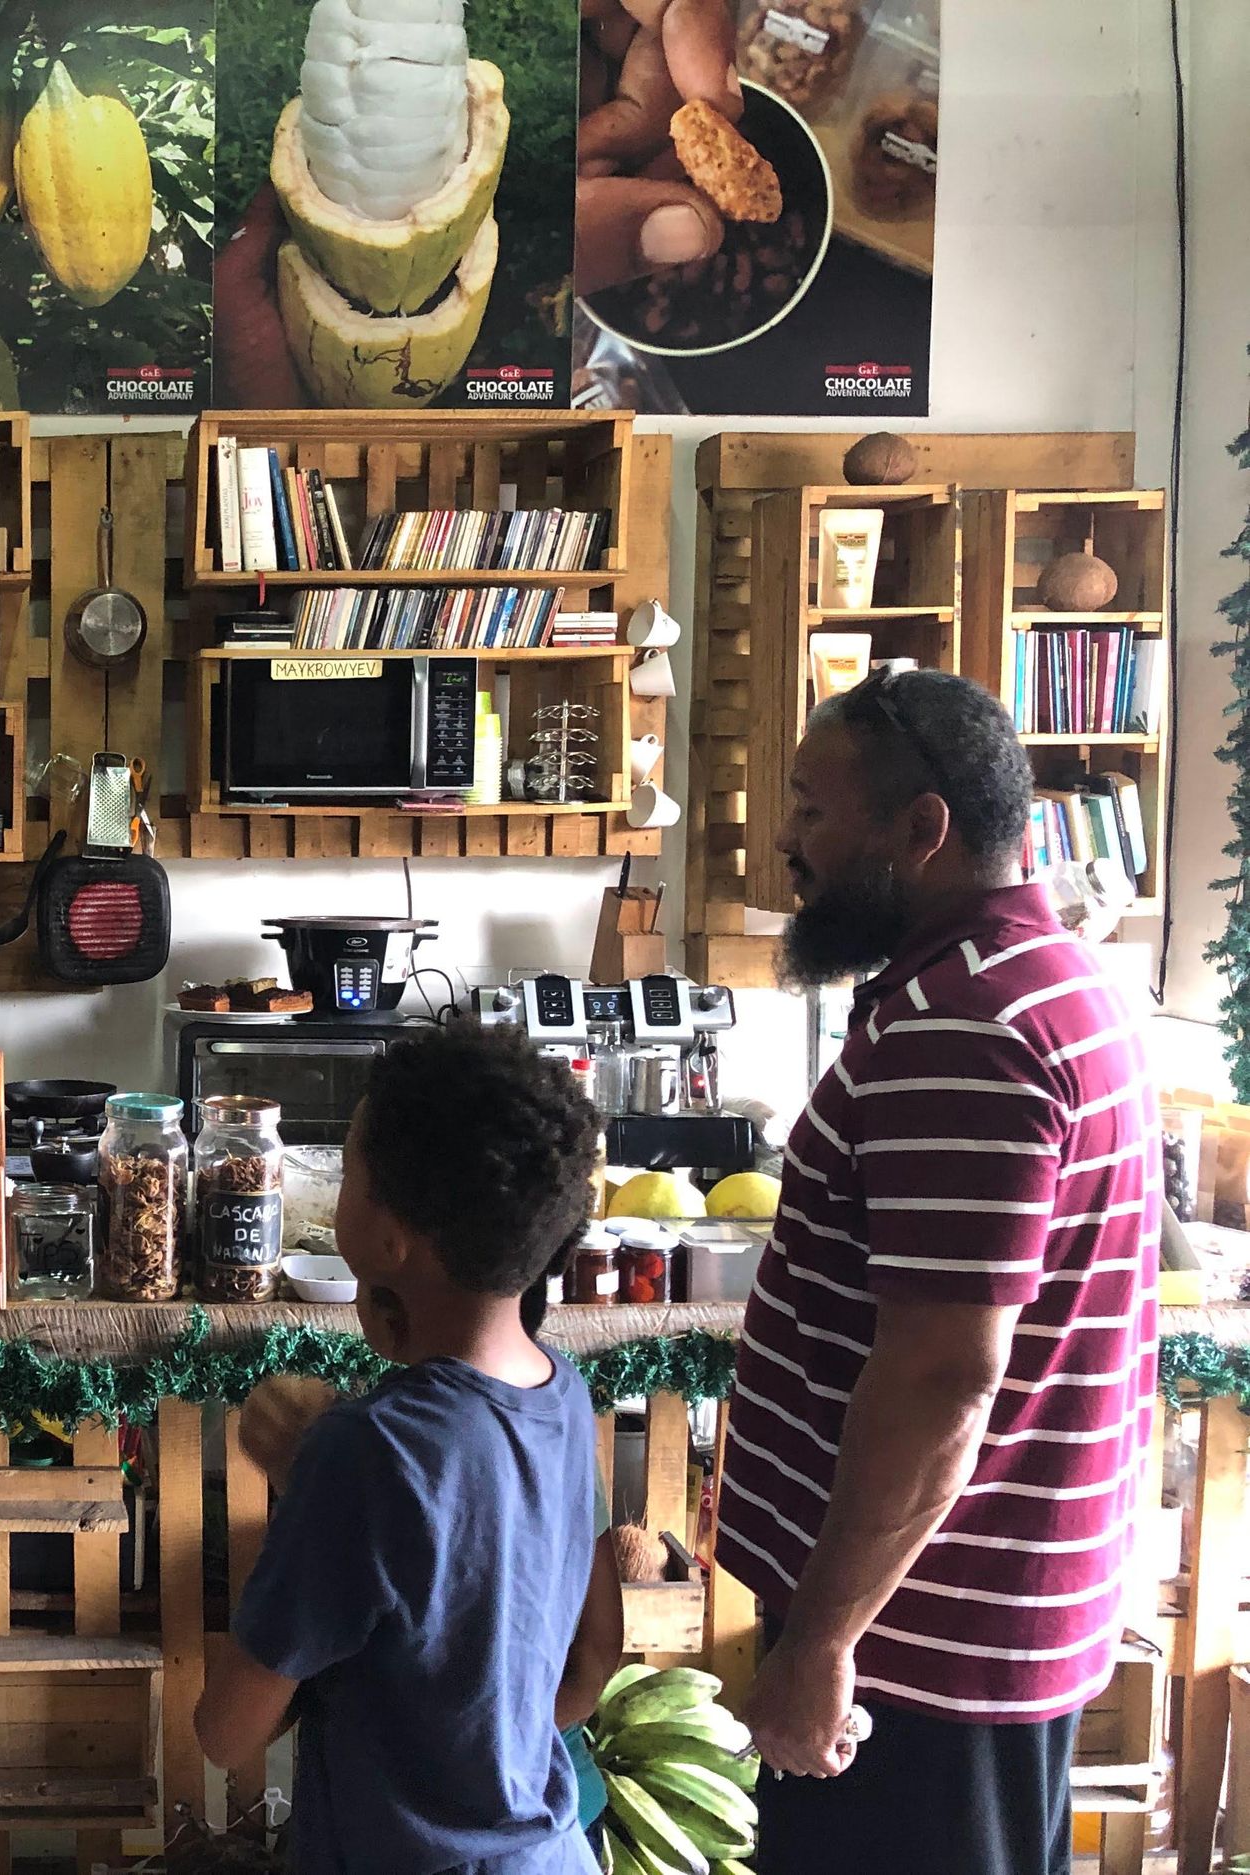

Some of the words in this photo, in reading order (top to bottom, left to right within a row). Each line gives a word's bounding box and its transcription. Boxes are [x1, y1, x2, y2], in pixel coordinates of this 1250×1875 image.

[140, 368, 161, 377] G&E
[499, 368, 521, 377] G&E
[858, 366, 879, 375] G&E
[106, 381, 194, 393] CHOCOLATE
[466, 381, 554, 393] CHOCOLATE
[825, 378, 912, 390] CHOCOLATE
[107, 392, 153, 400] ADVENTURE
[155, 392, 193, 400] COMPANY
[467, 392, 513, 400] ADVENTURE
[515, 392, 553, 400] COMPANY
[826, 389, 871, 397] ADVENTURE
[873, 389, 911, 397] COMPANY
[275, 662, 377, 678] MAYKROWYEV
[234, 1228, 261, 1243] DE
